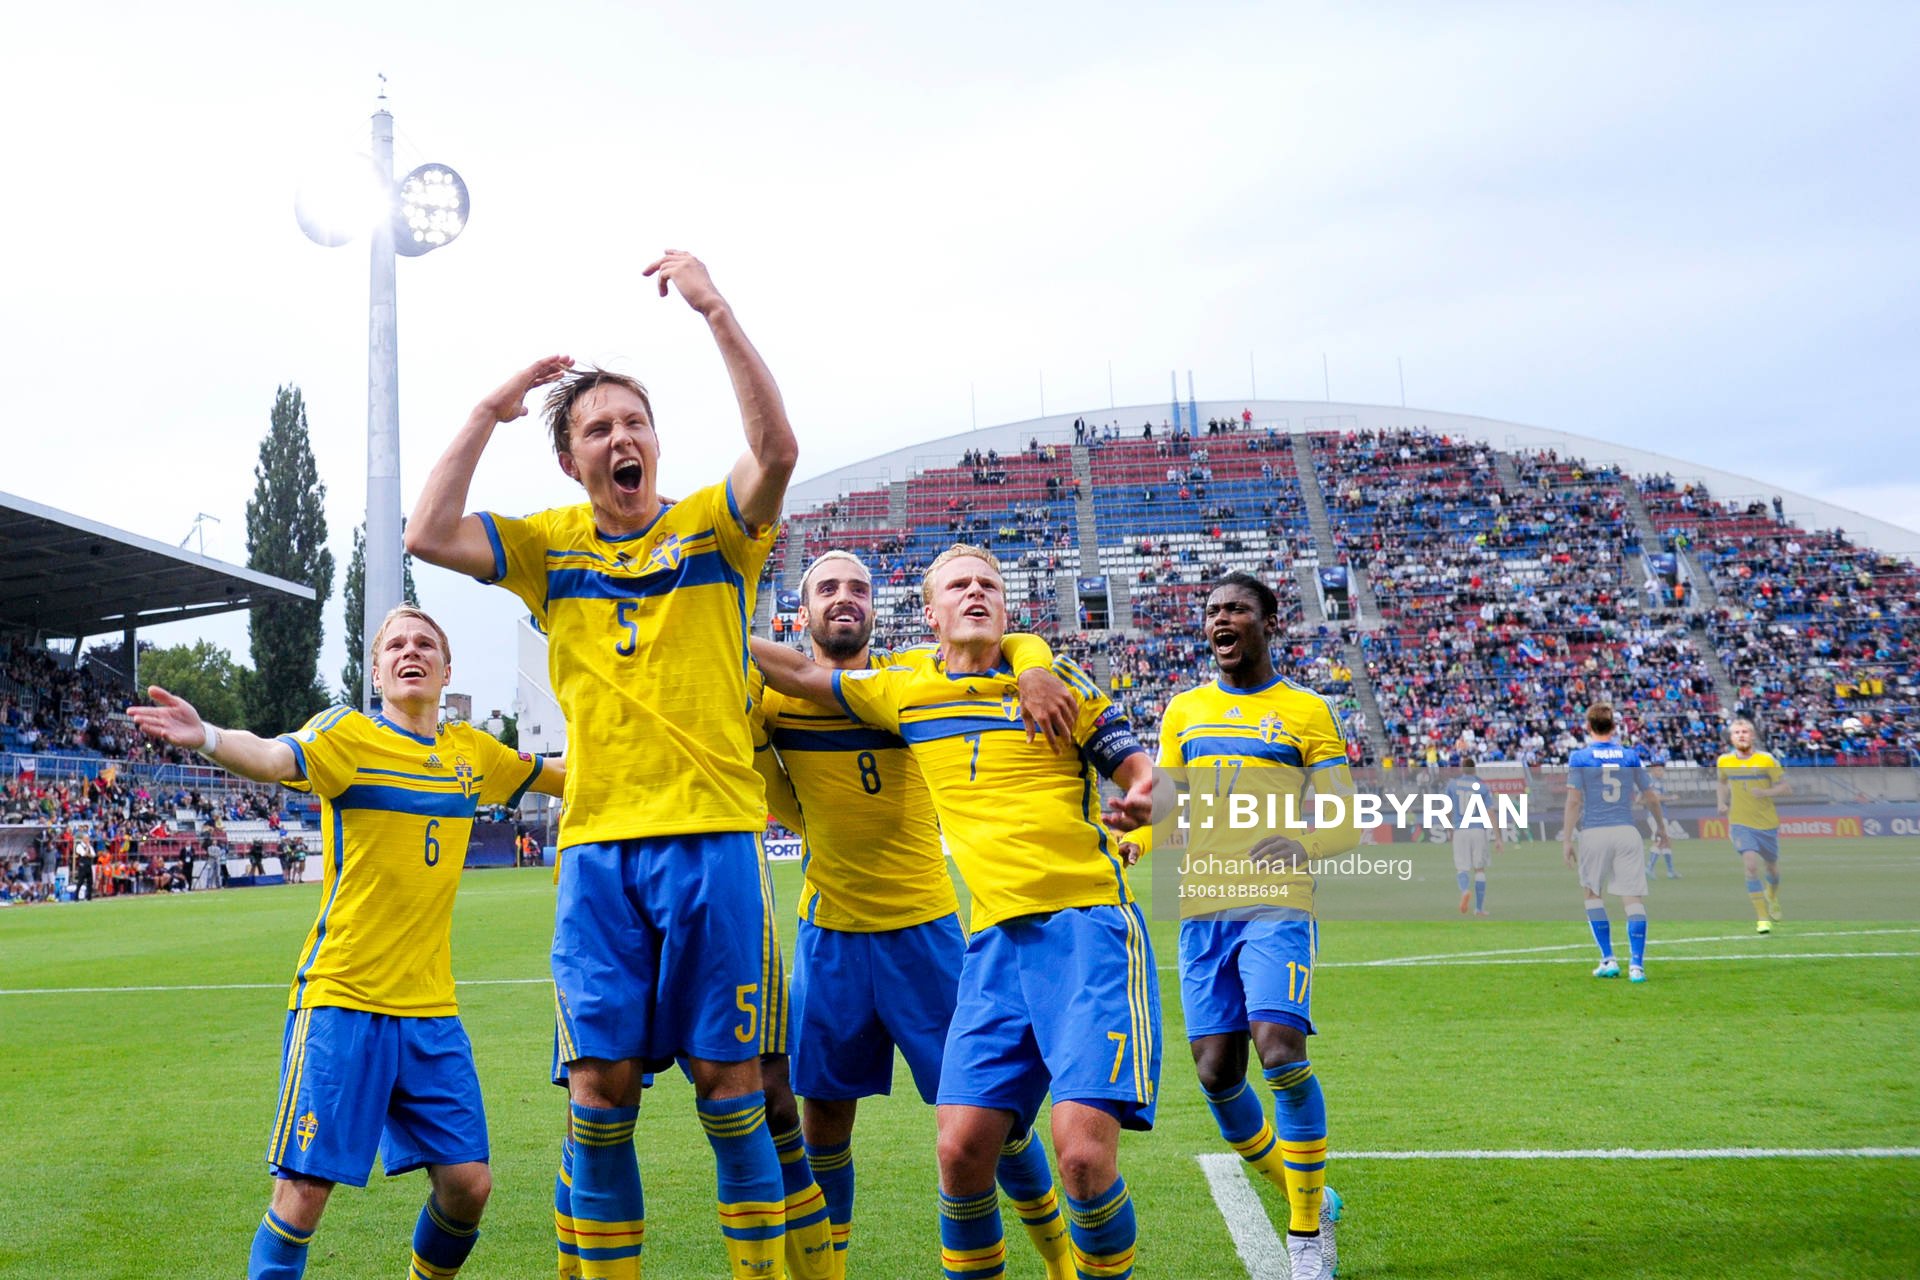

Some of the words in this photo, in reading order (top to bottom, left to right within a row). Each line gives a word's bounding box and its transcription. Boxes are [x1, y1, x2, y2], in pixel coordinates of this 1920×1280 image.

[615, 602, 638, 656] 5
[857, 751, 881, 795] 8
[964, 732, 981, 782] 7
[1213, 759, 1244, 798] 17
[1601, 763, 1622, 803] 5
[424, 819, 440, 867] 6
[1286, 961, 1309, 1004] 17
[735, 983, 758, 1043] 5
[1107, 1031, 1127, 1083] 7
